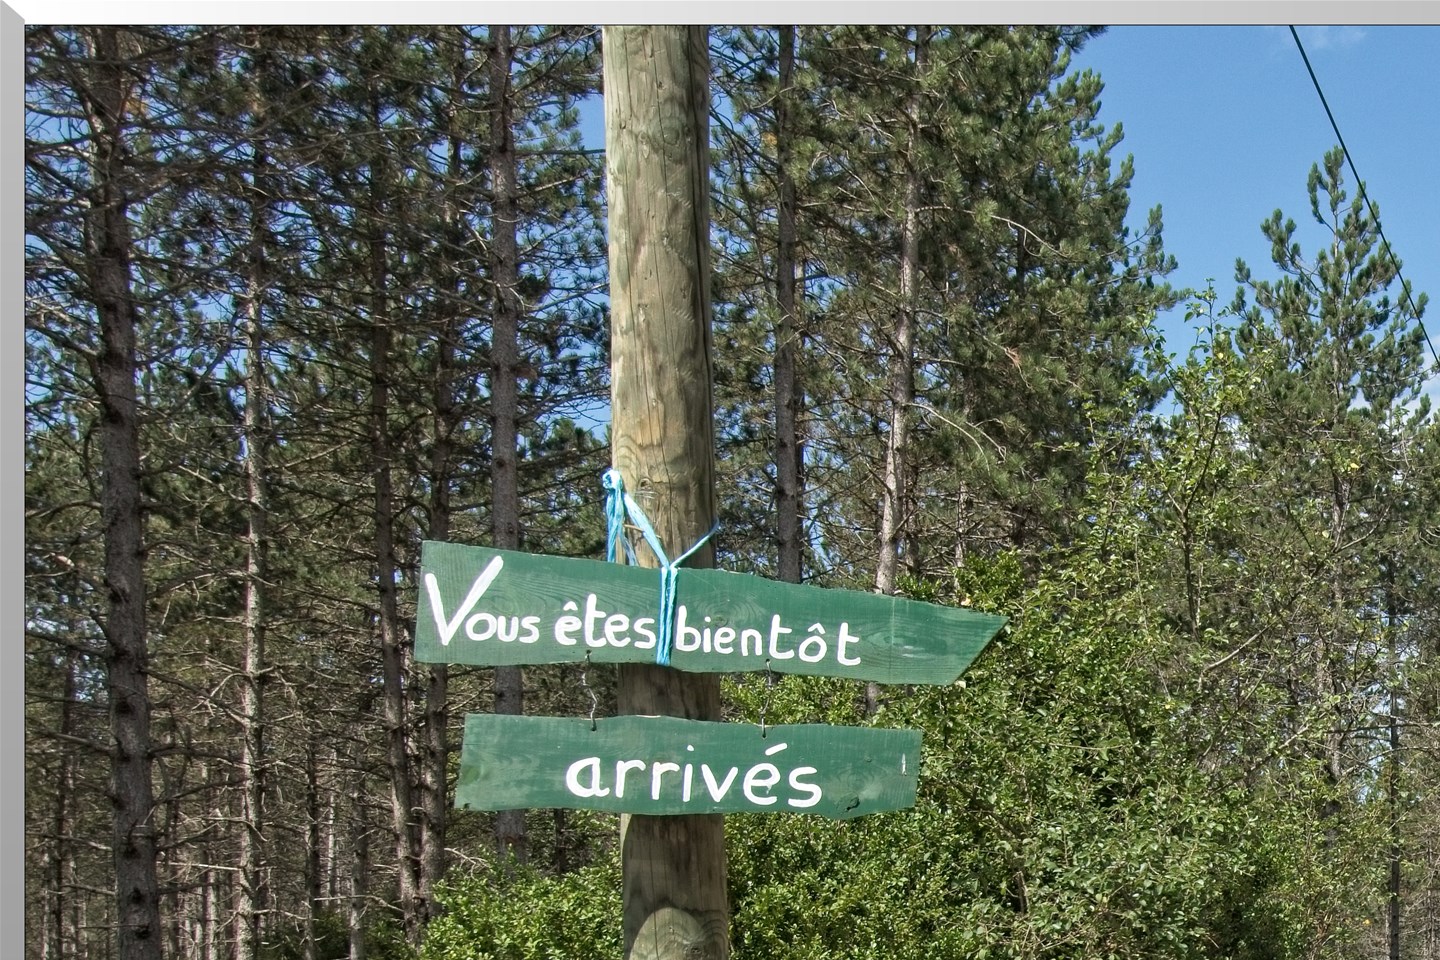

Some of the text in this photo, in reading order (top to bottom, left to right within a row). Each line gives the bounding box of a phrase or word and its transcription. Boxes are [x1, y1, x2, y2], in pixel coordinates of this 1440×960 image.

[424, 555, 862, 666] Vous êtes bientôt
[565, 743, 823, 808] arrivés
